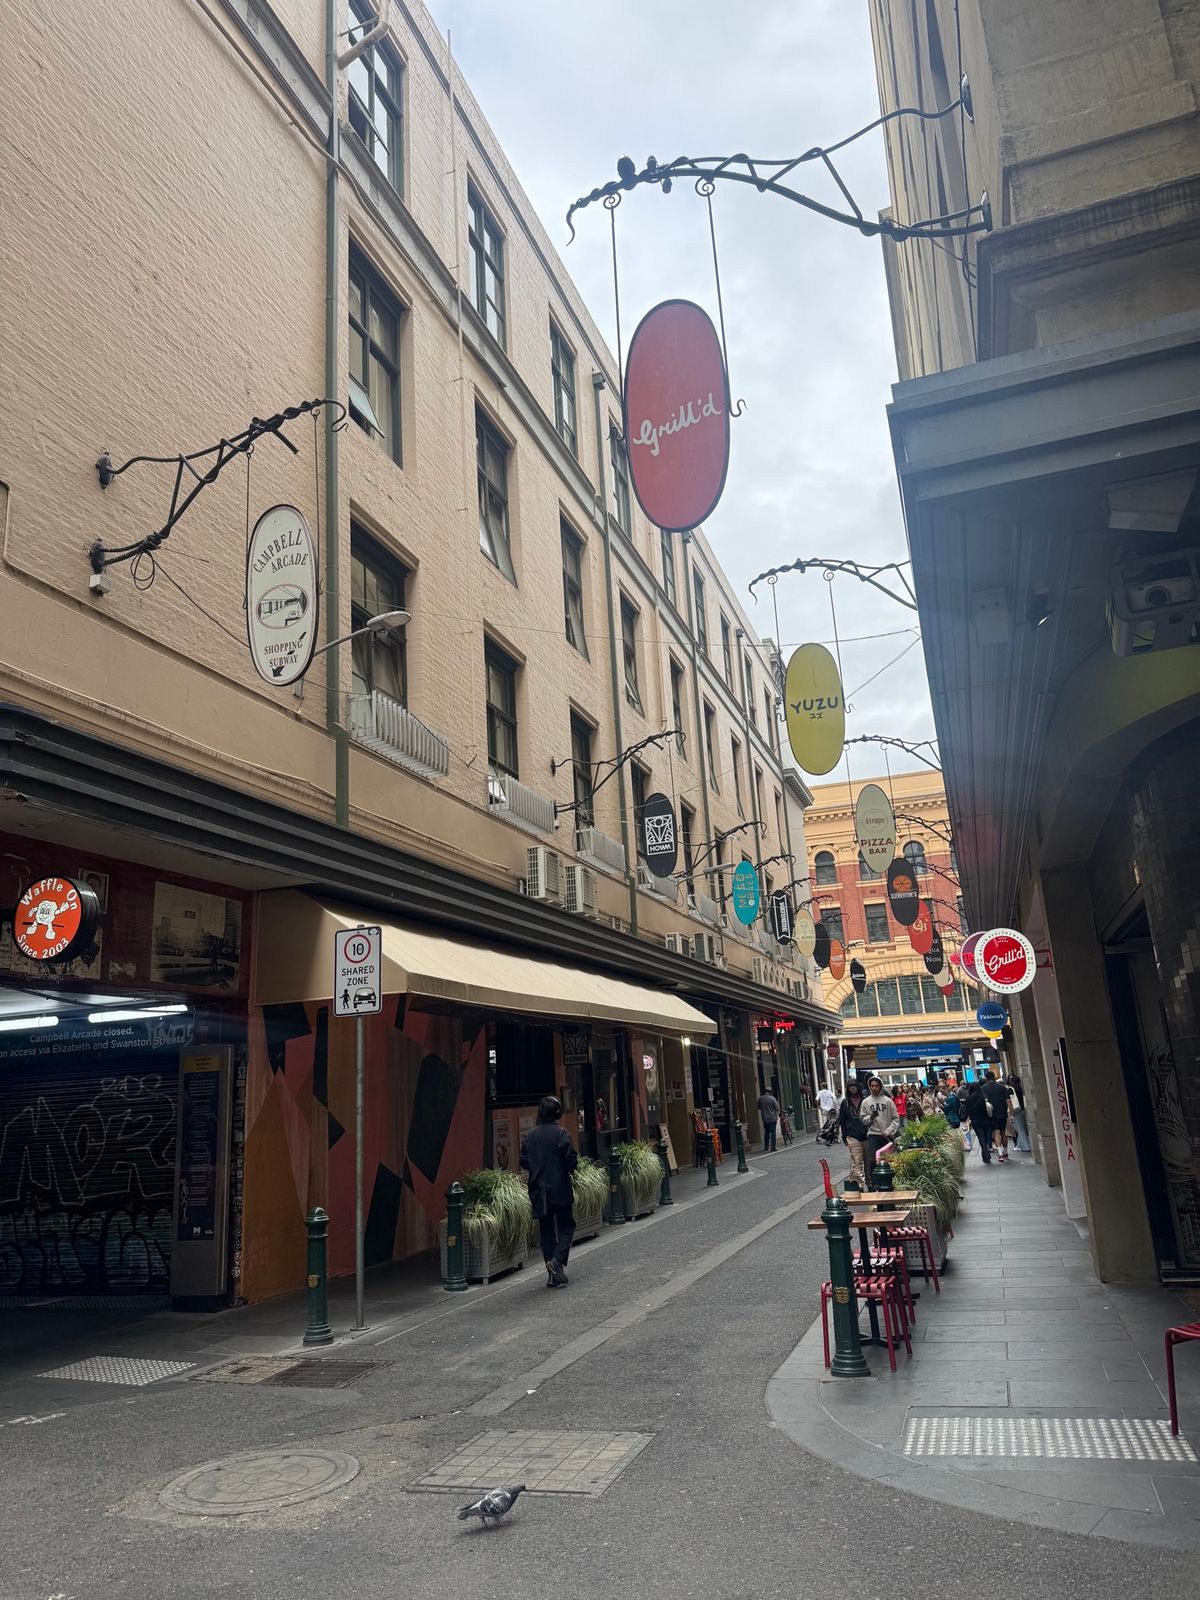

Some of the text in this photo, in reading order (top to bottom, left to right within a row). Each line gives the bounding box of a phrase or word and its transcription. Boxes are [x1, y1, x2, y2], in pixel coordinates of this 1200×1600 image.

[633, 392, 721, 456] Grill'd
[253, 528, 302, 573] CAMPBELL
[271, 553, 308, 573] ARCADE
[264, 639, 302, 655] SHOPPING
[269, 654, 299, 667] SUBWAY
[790, 696, 838, 714] YUZU
[860, 837, 894, 847] PIZZA
[20, 878, 64, 906] Waffle
[66, 889, 78, 910] On
[17, 934, 69, 958] Since 2003
[352, 943, 364, 956] 10
[985, 946, 1025, 975] Grill'd
[341, 965, 375, 977] SHARED
[347, 976, 369, 987] ZONE
[29, 1031, 69, 1044] Campbell
[71, 1029, 102, 1040] Arcade
[103, 1026, 135, 1037] closed.
[9, 1047, 37, 1057] access
[38, 1045, 51, 1055] via
[52, 1041, 91, 1053] Elizabeth
[92, 1040, 109, 1050] and
[110, 1037, 151, 1049] Swanston
[869, 1103, 887, 1112] GAP
